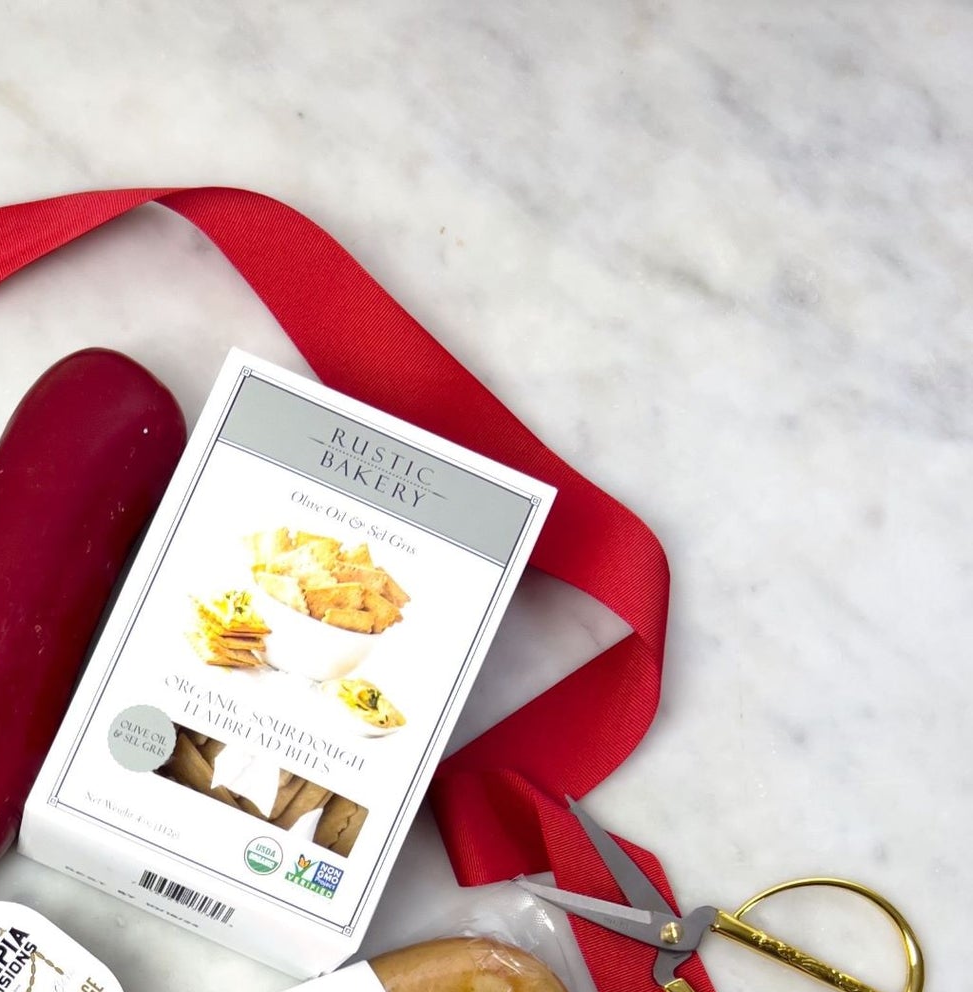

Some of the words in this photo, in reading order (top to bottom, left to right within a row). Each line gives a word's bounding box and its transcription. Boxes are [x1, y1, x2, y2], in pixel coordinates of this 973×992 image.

[331, 427, 435, 487] RUSTIC
[320, 450, 428, 509] BAKERY
[291, 488, 323, 514] Olive
[326, 505, 347, 522] Oil
[120, 719, 149, 739] OLIVE
[151, 731, 168, 747] OIL
[164, 674, 238, 716] ORGANIC
[252, 710, 366, 771] SOURDOUGH
[124, 733, 140, 748] SEL
[142, 740, 166, 759] GRIS
[255, 843, 277, 858] USDA
[316, 870, 339, 885] GMO
[320, 863, 342, 878] NON
[288, 872, 333, 898] VERIFIED
